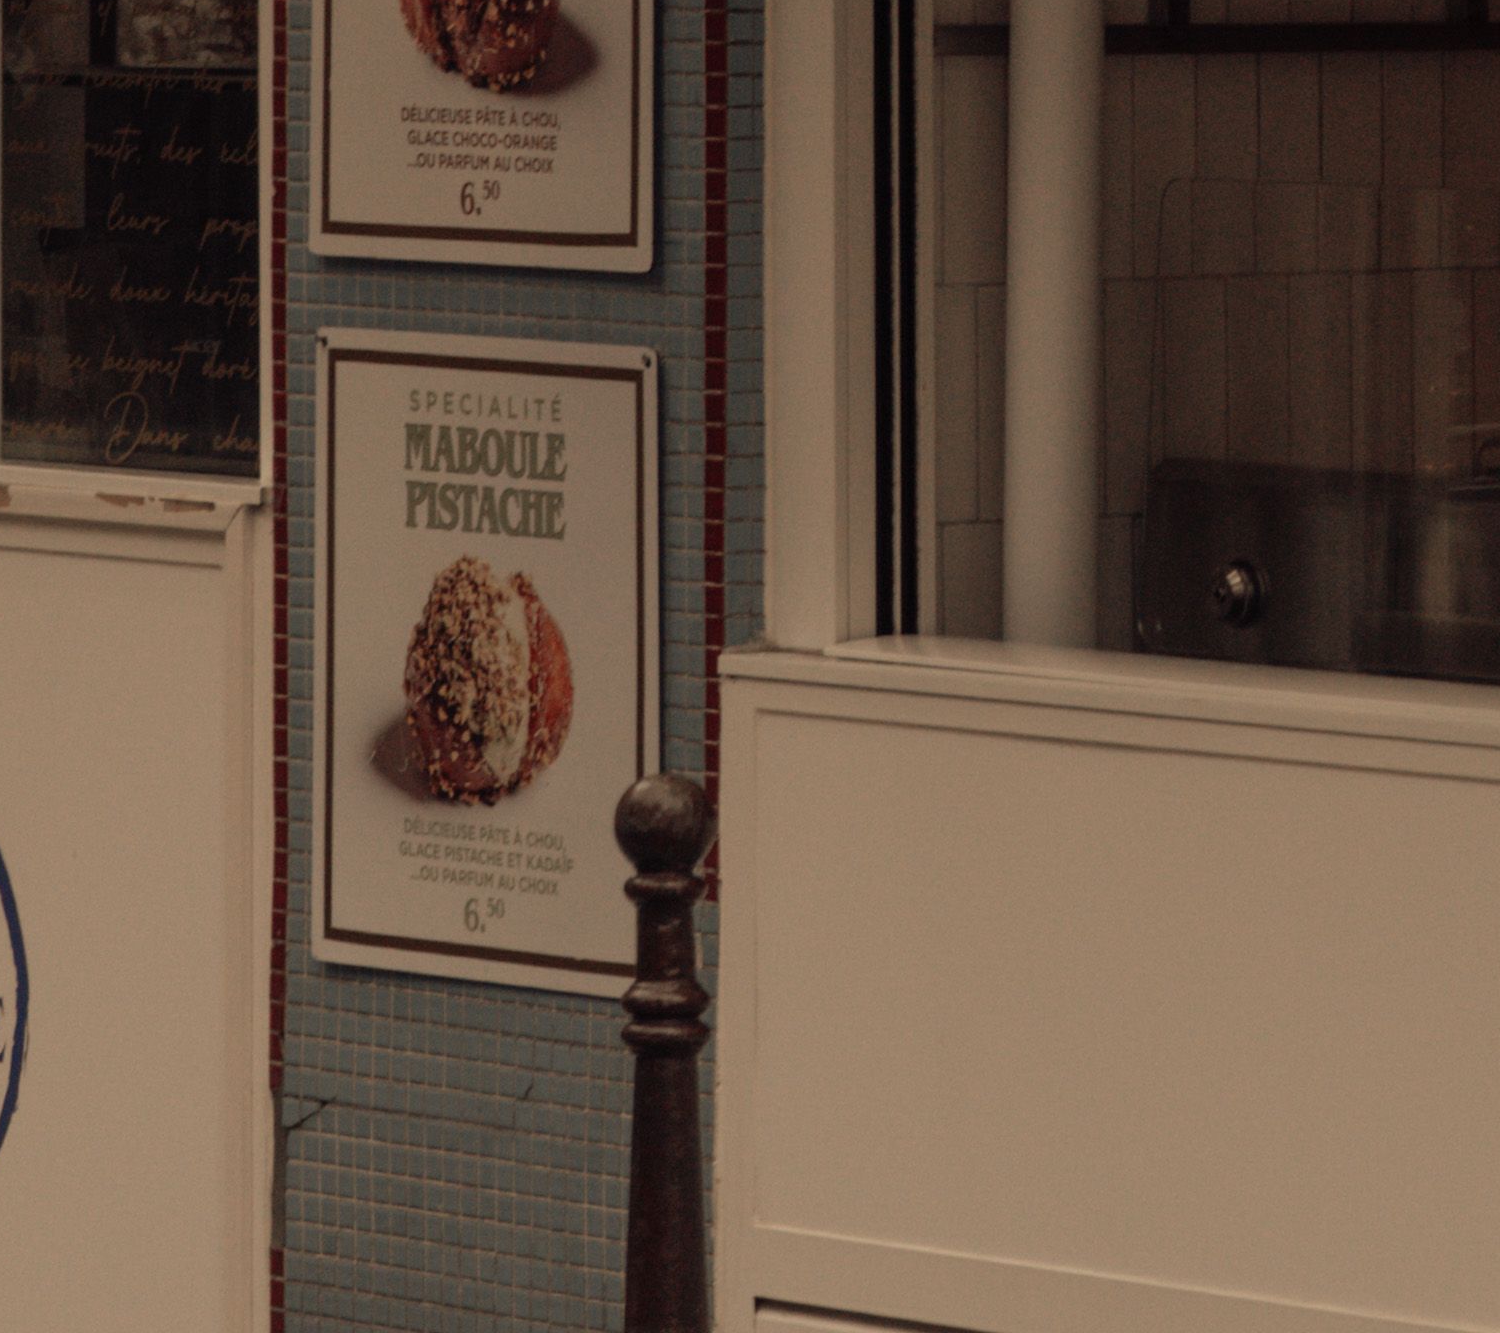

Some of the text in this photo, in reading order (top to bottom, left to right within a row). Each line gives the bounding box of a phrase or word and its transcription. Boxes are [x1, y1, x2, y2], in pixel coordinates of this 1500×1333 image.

[459, 178, 501, 217] 6.50
[409, 388, 563, 424] SPECIALITÉ
[403, 421, 569, 483] MABOULE
[404, 479, 567, 542] PISTACHE
